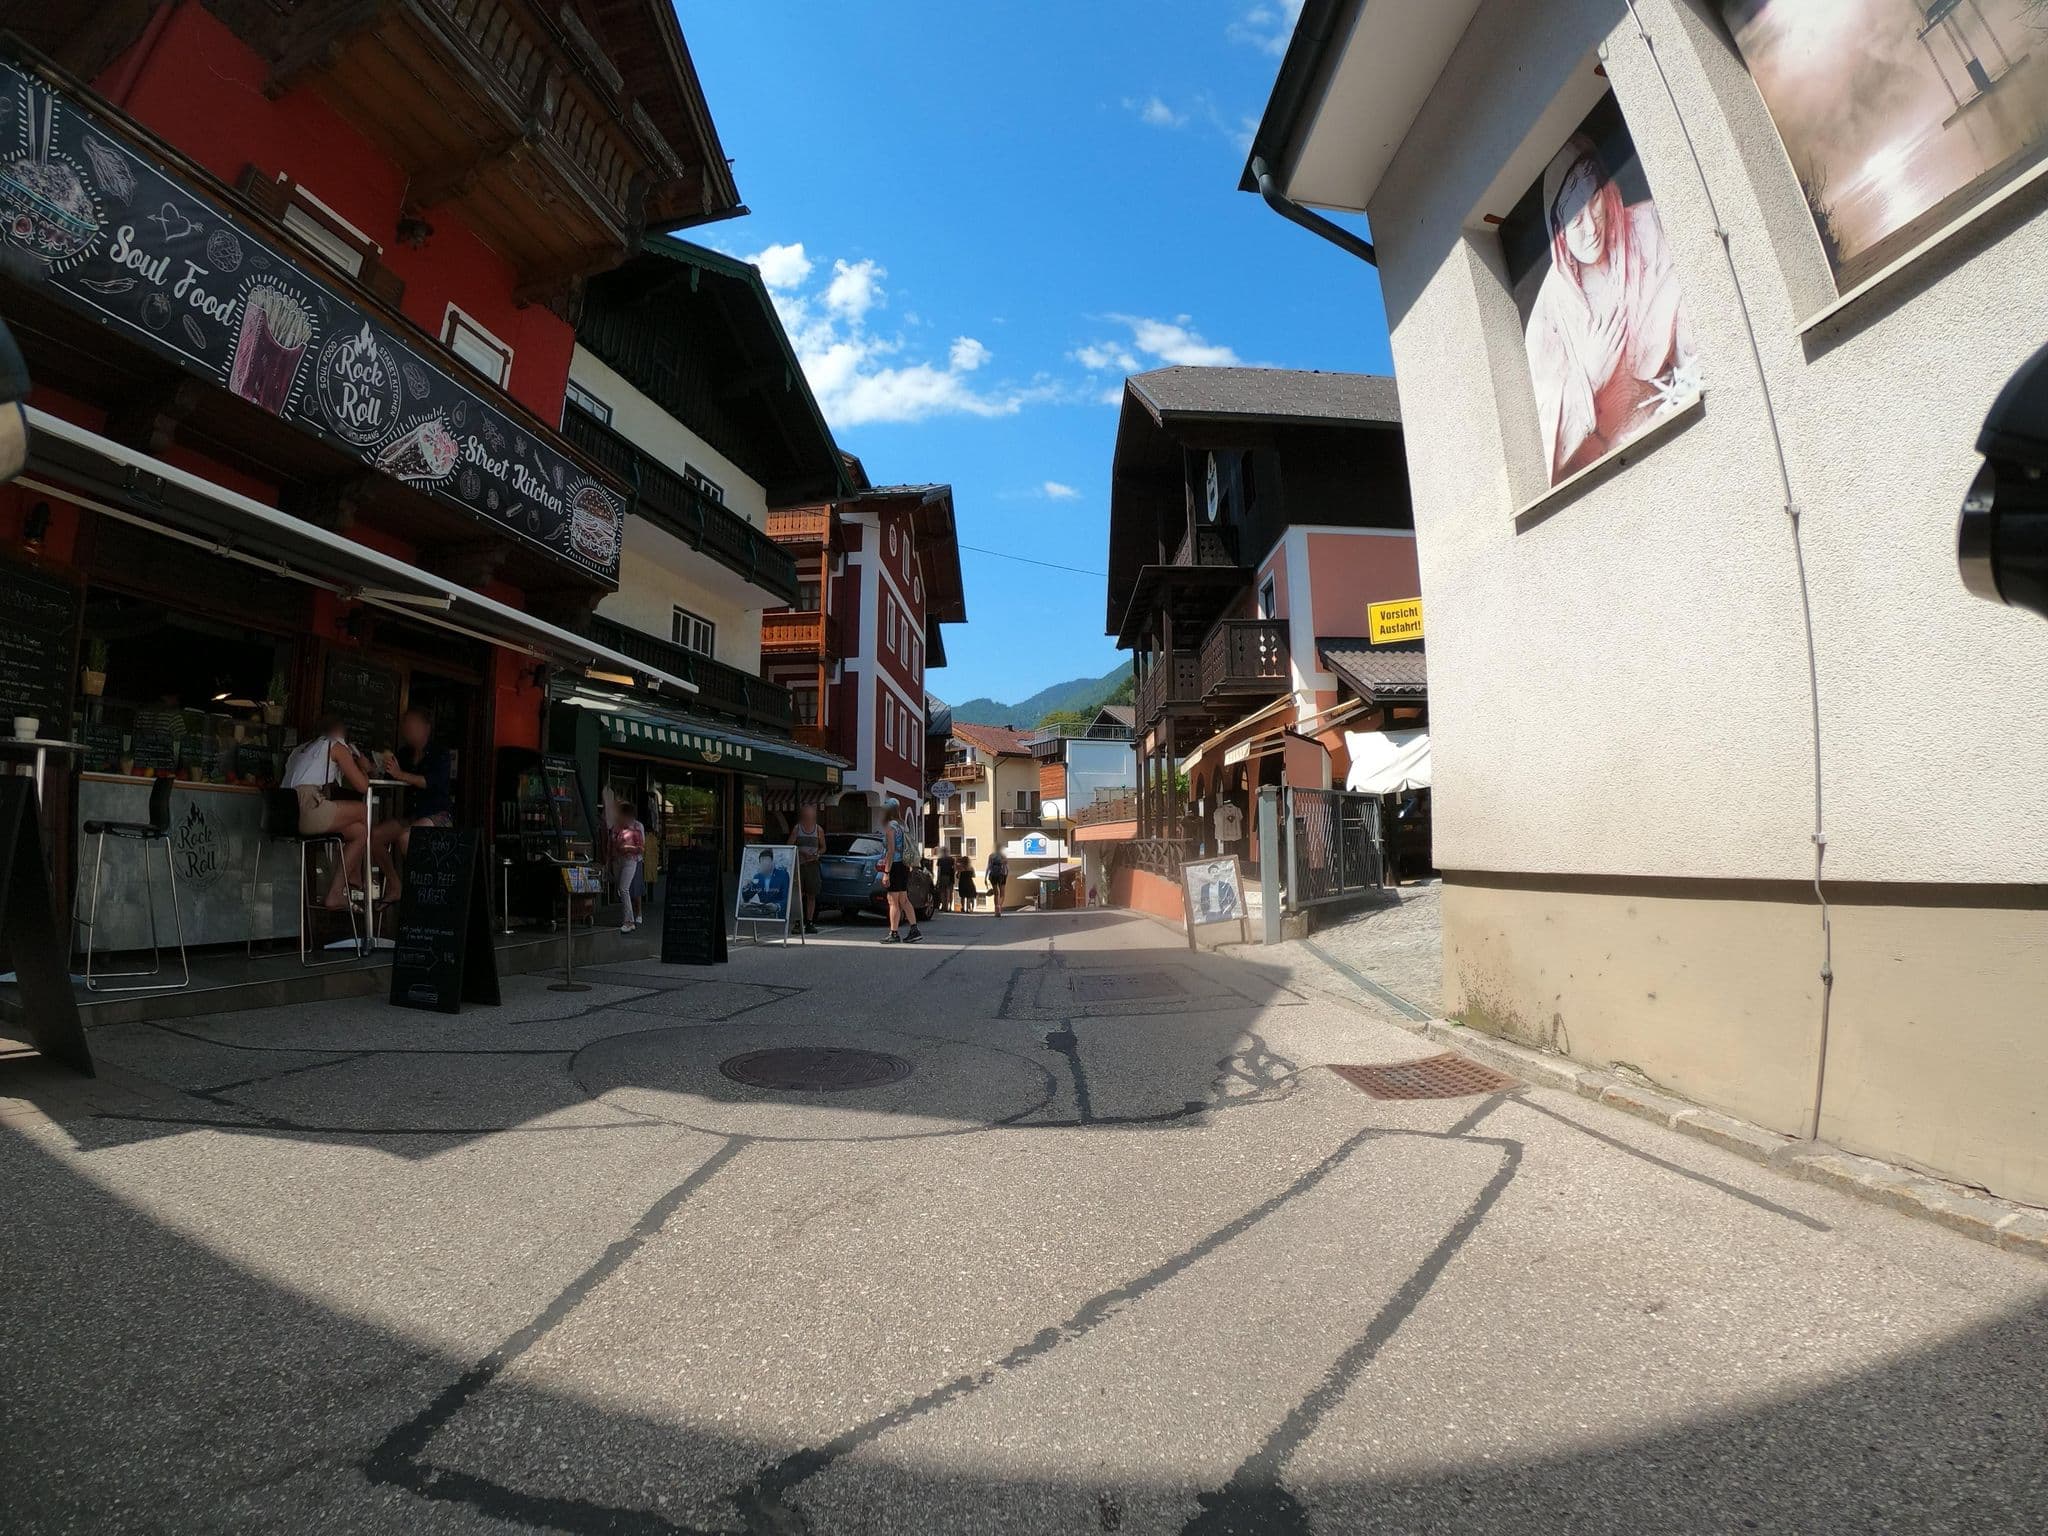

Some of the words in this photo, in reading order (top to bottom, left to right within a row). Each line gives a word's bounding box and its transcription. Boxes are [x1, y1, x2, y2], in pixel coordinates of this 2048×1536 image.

[110, 225, 171, 286] Soul
[174, 259, 237, 326] Food
[322, 341, 337, 363] FOOD
[319, 365, 328, 389] SOUL
[335, 343, 385, 387] Rock
[361, 384, 372, 398] n
[379, 347, 395, 376] STREET
[390, 378, 399, 417] KITCHEN
[336, 382, 382, 427] Roll
[465, 435, 510, 481] Street
[512, 464, 564, 515] Kitchen
[1380, 607, 1418, 620] Vorsicht
[1380, 621, 1420, 634] Ausfahrt!
[177, 825, 213, 849] Rock
[185, 851, 216, 878] Roll
